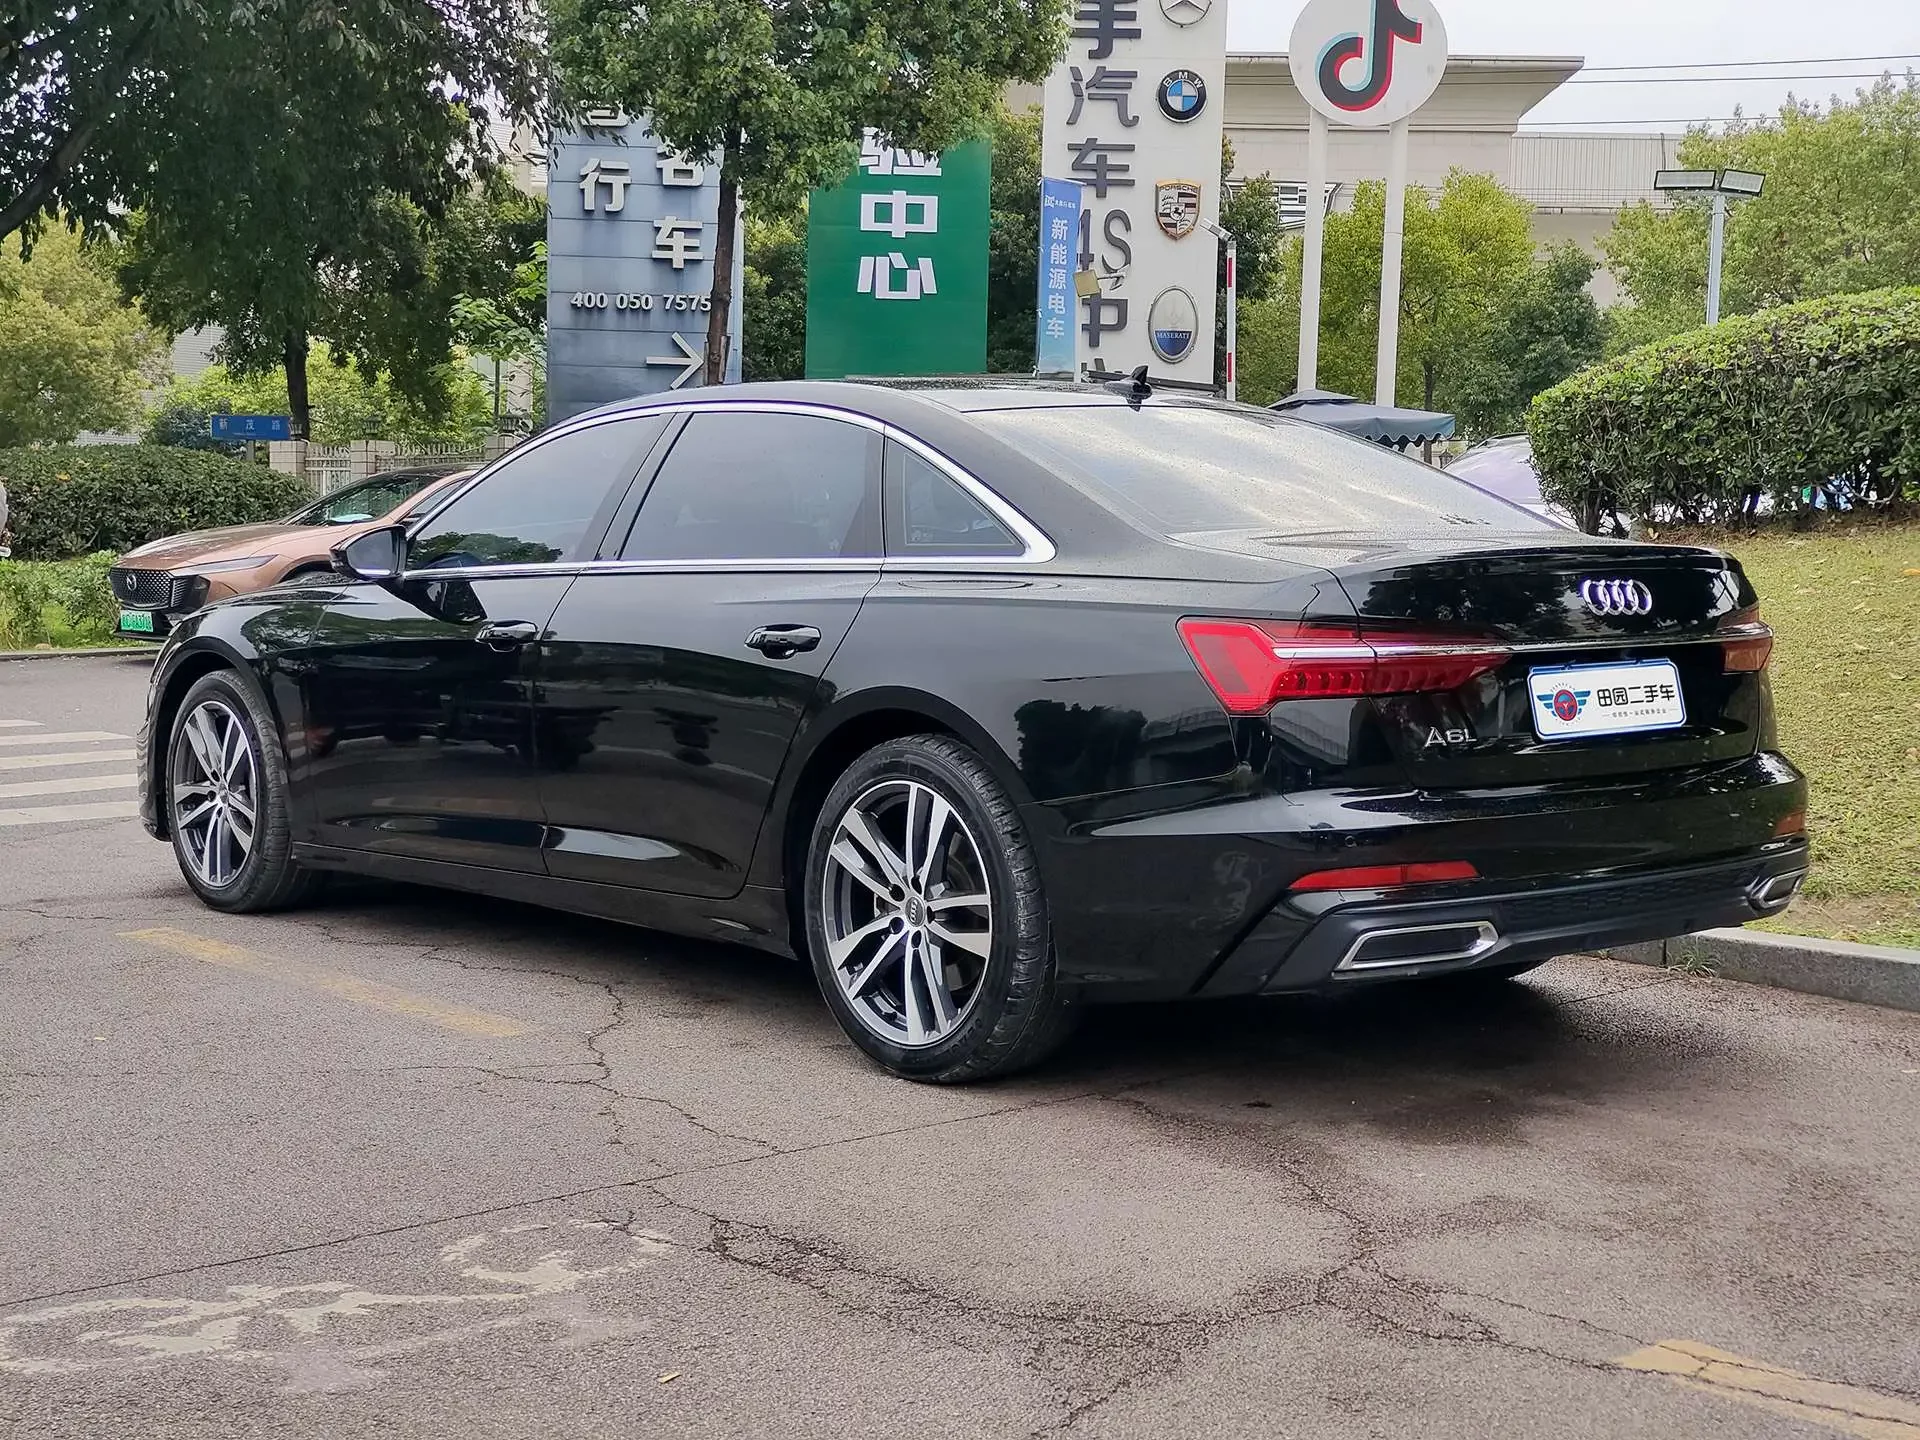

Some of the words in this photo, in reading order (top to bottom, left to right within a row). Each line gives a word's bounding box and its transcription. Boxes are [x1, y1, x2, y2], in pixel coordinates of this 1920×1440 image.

[1163, 72, 1203, 88] BMW
[1159, 185, 1198, 193] PORSCHE
[1046, 217, 1068, 339] 新能源电车
[570, 292, 608, 309] 400
[616, 294, 653, 310] 050
[664, 295, 712, 312] 7575
[1597, 684, 1676, 707] 田园二手车
[1424, 726, 1477, 747] A6L
